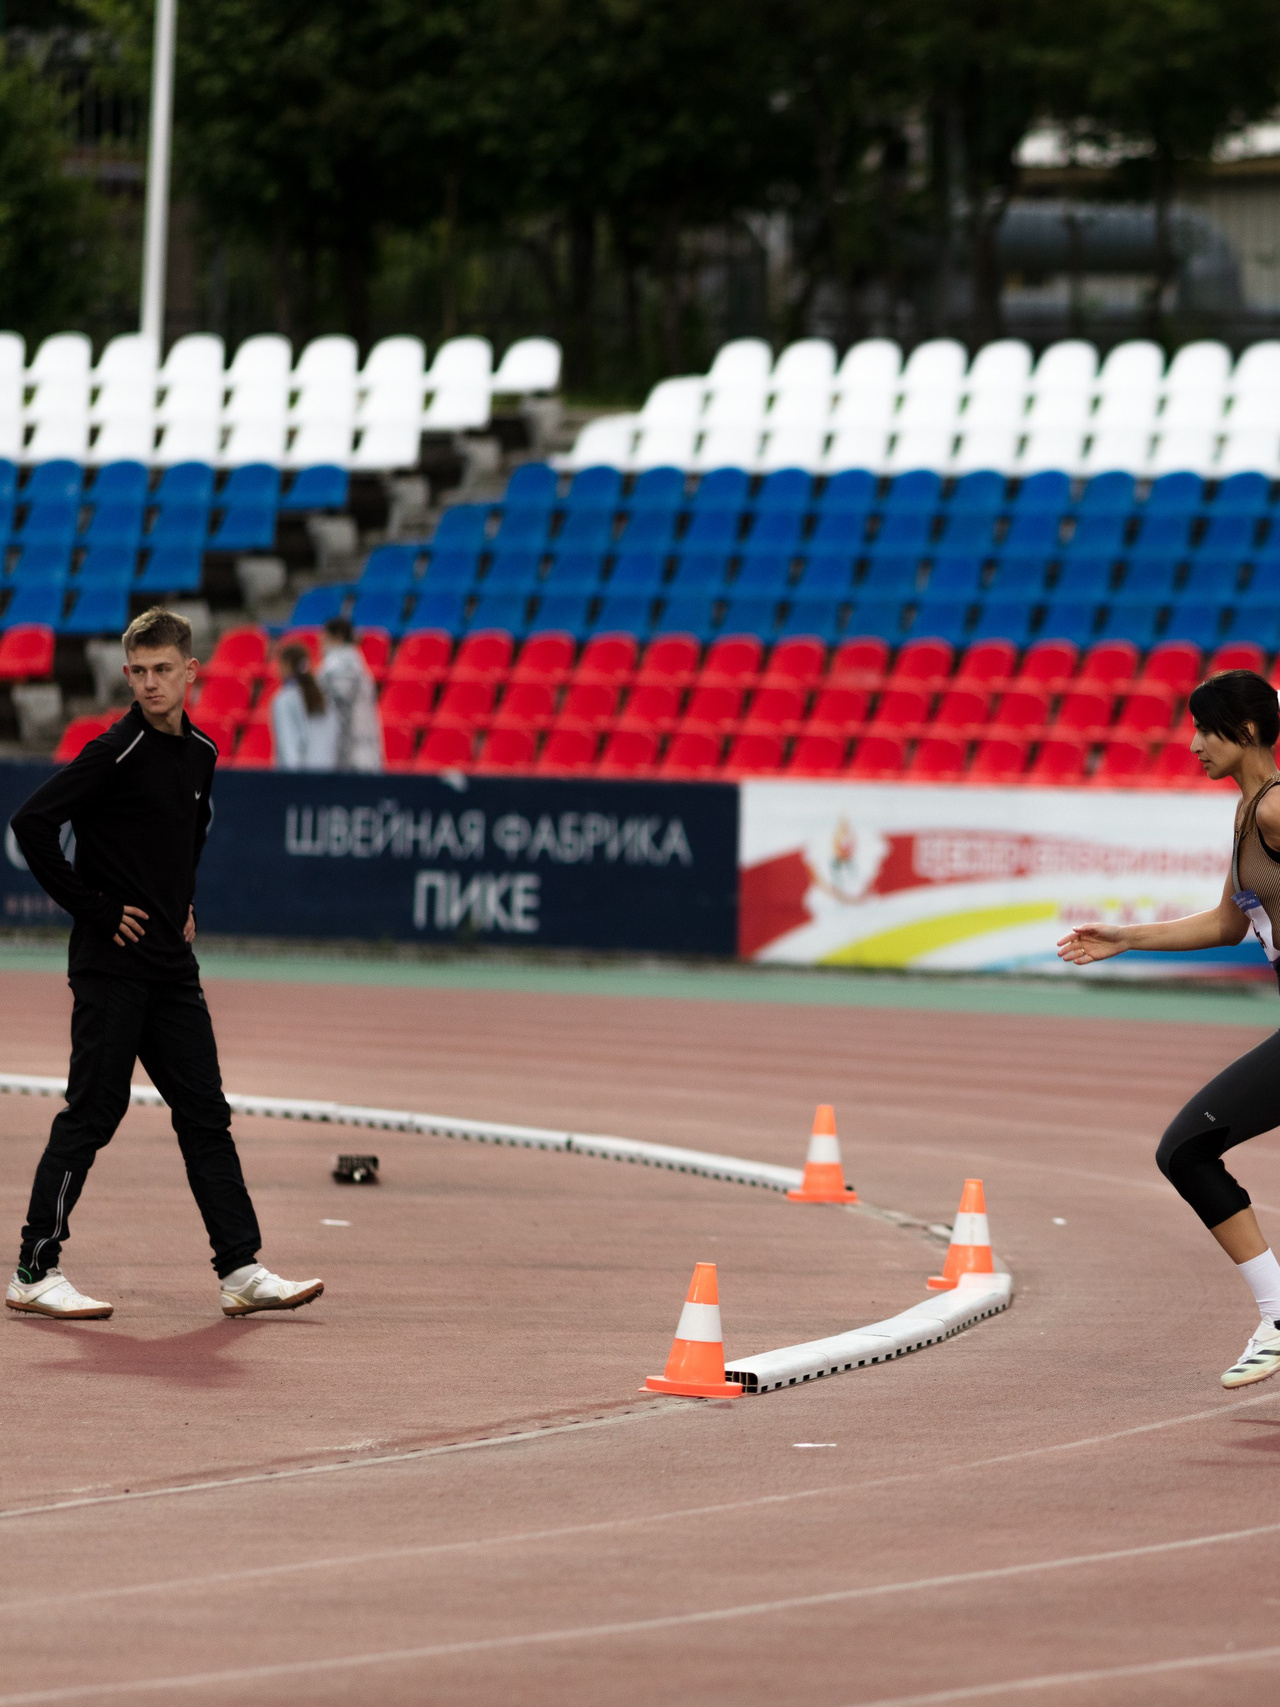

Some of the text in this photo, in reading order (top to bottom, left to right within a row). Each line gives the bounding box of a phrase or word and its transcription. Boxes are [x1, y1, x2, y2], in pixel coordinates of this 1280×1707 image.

[284, 799, 693, 866] ШВЕЙНАЯ ФАБРИКА
[412, 869, 541, 932] ПИКЕ
